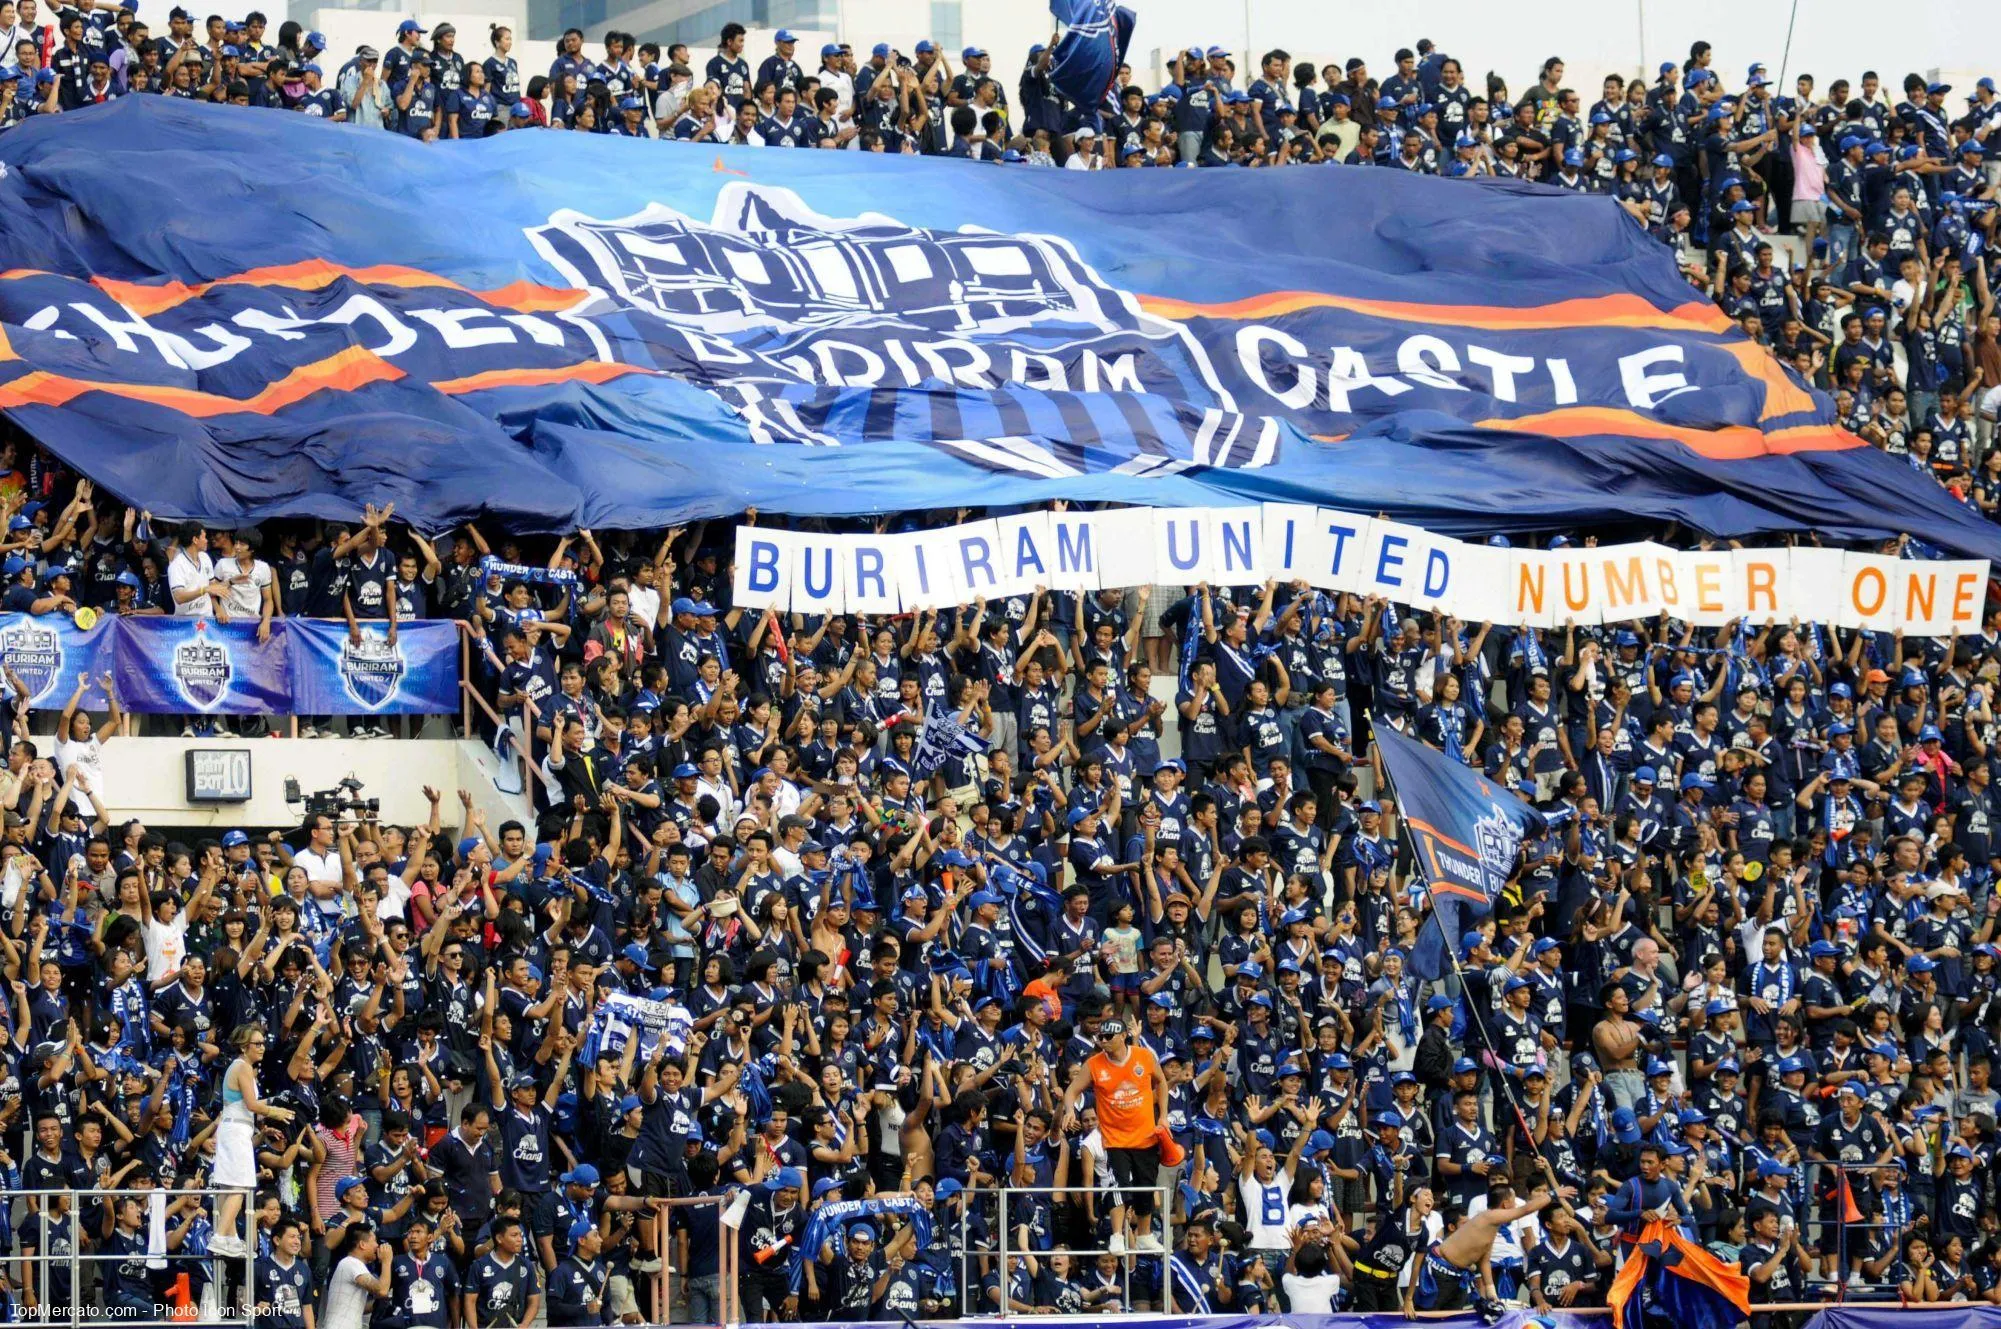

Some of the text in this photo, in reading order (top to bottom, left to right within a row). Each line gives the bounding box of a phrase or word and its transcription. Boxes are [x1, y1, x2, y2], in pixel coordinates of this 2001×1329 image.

[485, 561, 529, 575] THUNDER
[748, 520, 1978, 622] BURIRAM UNITED NUMBER ONE
[290, 580, 308, 591] Chang
[396, 610, 416, 620] hang
[4, 653, 55, 665] BURIRAM
[181, 667, 225, 677] BURIRAM
[347, 662, 398, 672] BURIRAM
[925, 687, 945, 697] Chan
[1133, 730, 1155, 740] hang
[1194, 725, 1216, 735] Chang
[221, 754, 248, 795] 10
[196, 778, 220, 790] EXIT
[1156, 830, 1181, 840] Chan
[1436, 851, 1482, 887] THUNDER
[403, 980, 419, 990] ang
[1513, 1054, 1536, 1064] Chan
[1251, 1064, 1274, 1075] Chang
[1337, 1127, 1362, 1140] Chang
[513, 1149, 542, 1163] Chang
[1261, 1186, 1285, 1225] B
[886, 1298, 917, 1311] Chang
